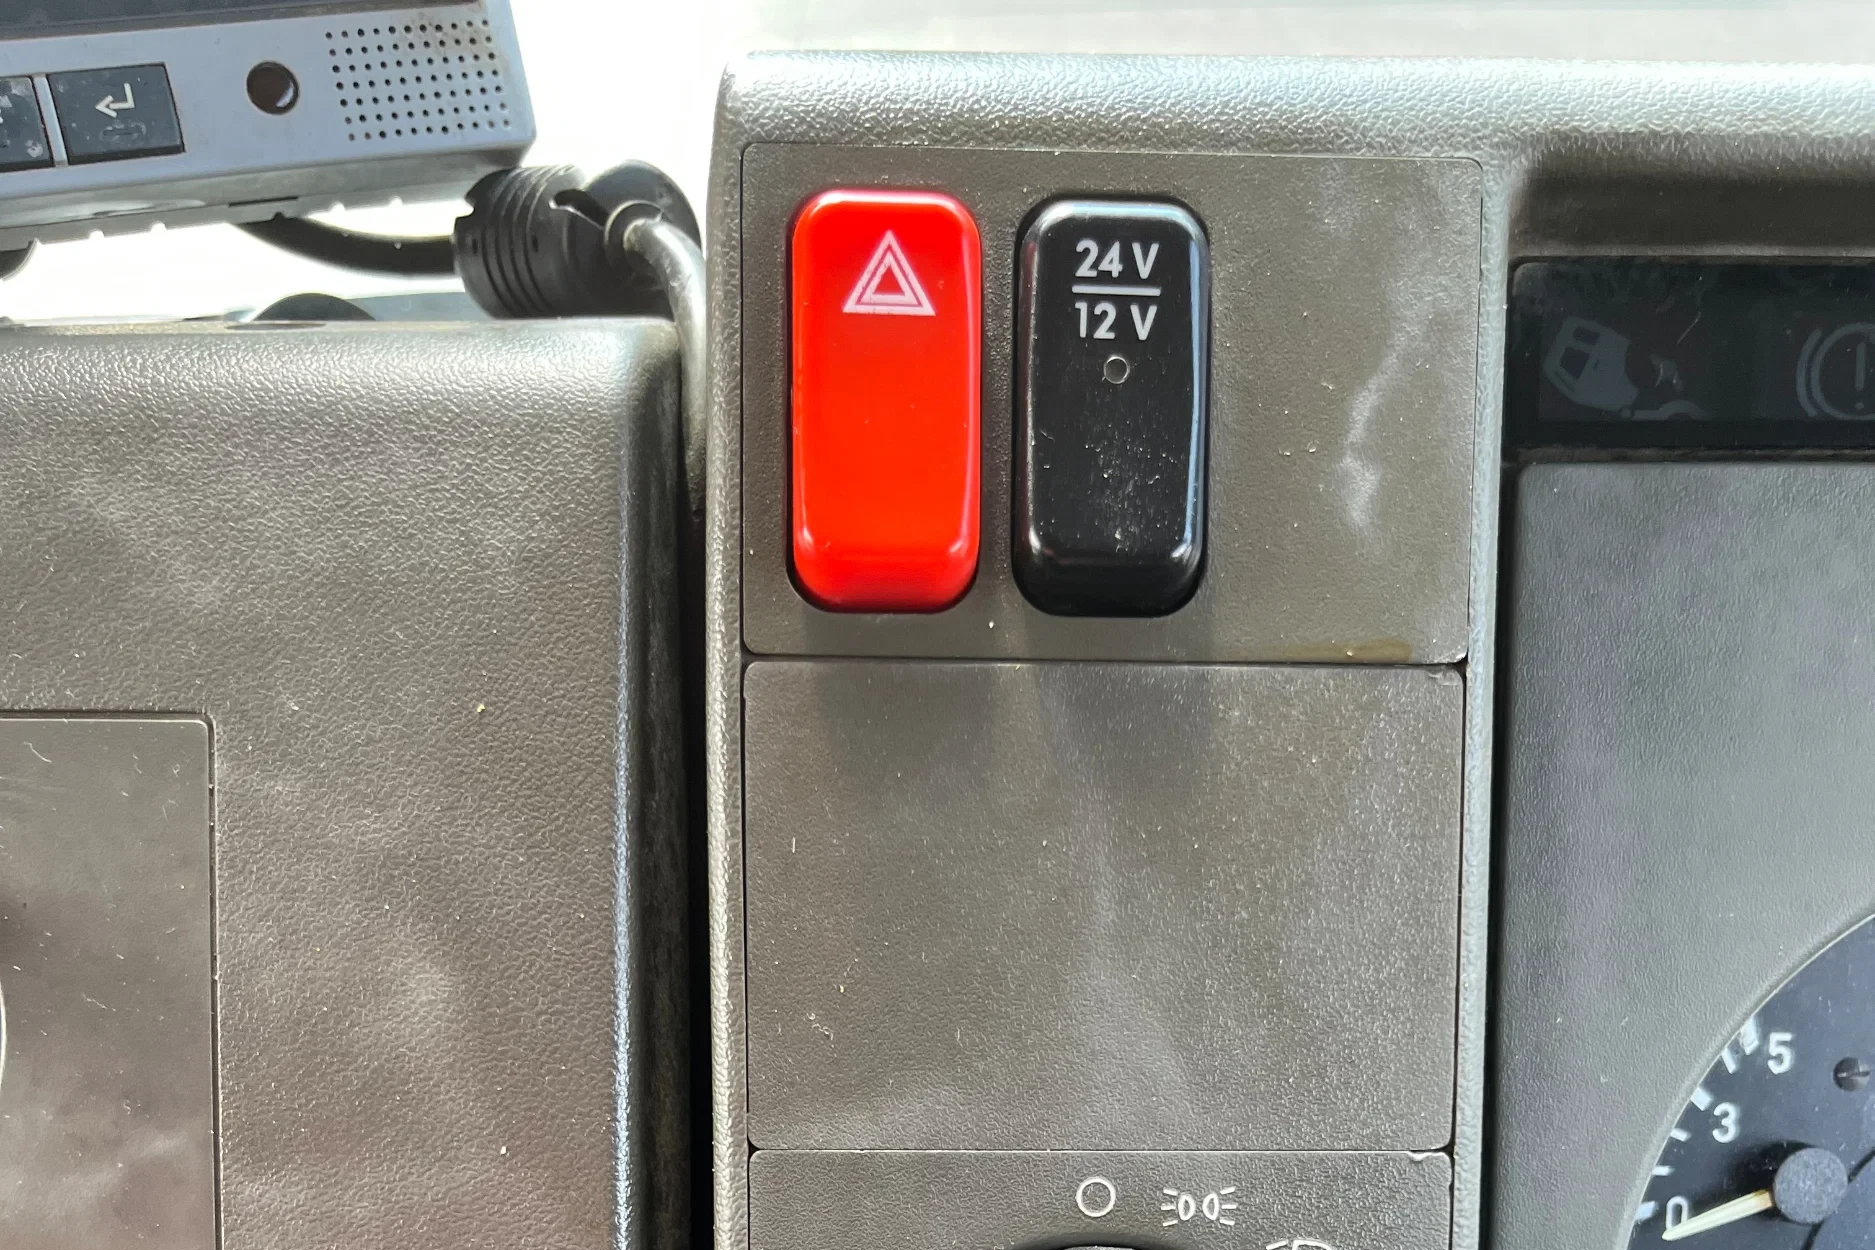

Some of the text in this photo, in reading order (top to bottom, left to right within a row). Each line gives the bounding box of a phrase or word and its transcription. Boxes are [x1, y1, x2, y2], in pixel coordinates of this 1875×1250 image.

[1075, 239, 1160, 279] 24 V
[1075, 301, 1158, 341] 12 V
[1767, 1032, 1793, 1075] 5
[1712, 1102, 1738, 1144] 3
